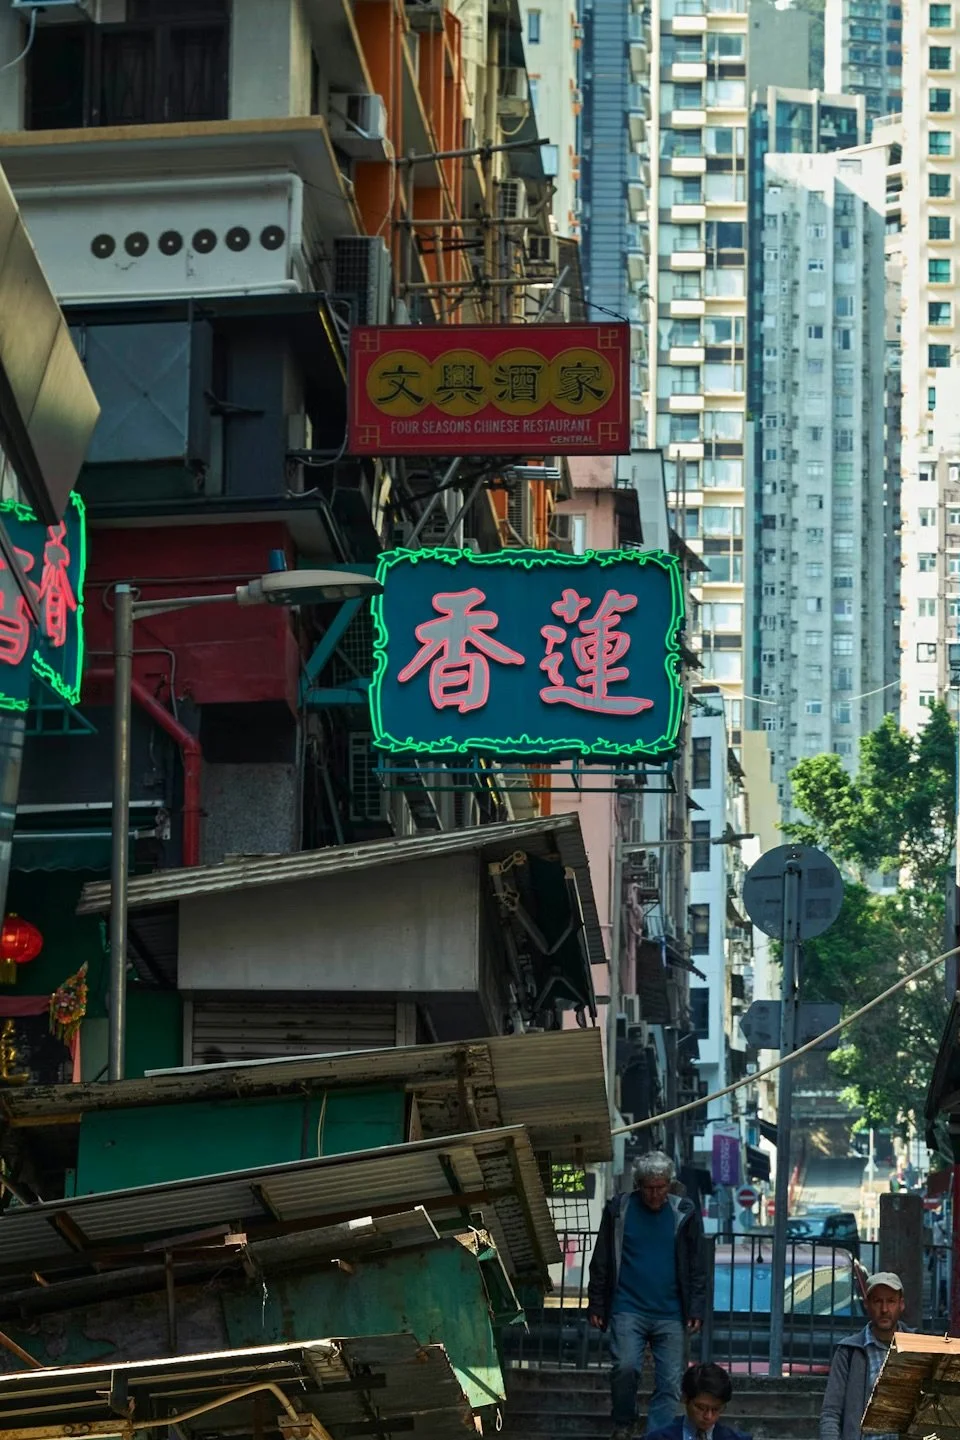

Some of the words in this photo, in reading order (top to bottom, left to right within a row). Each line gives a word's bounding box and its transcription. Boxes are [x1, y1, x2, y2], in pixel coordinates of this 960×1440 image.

[377, 361, 607, 406] 文興酒家
[390, 420, 420, 435] FOUR
[422, 420, 472, 435] SEASONS
[473, 419, 521, 434] CHINESE
[522, 418, 592, 433] RESTAURANT
[550, 435, 596, 445] CENTRAL
